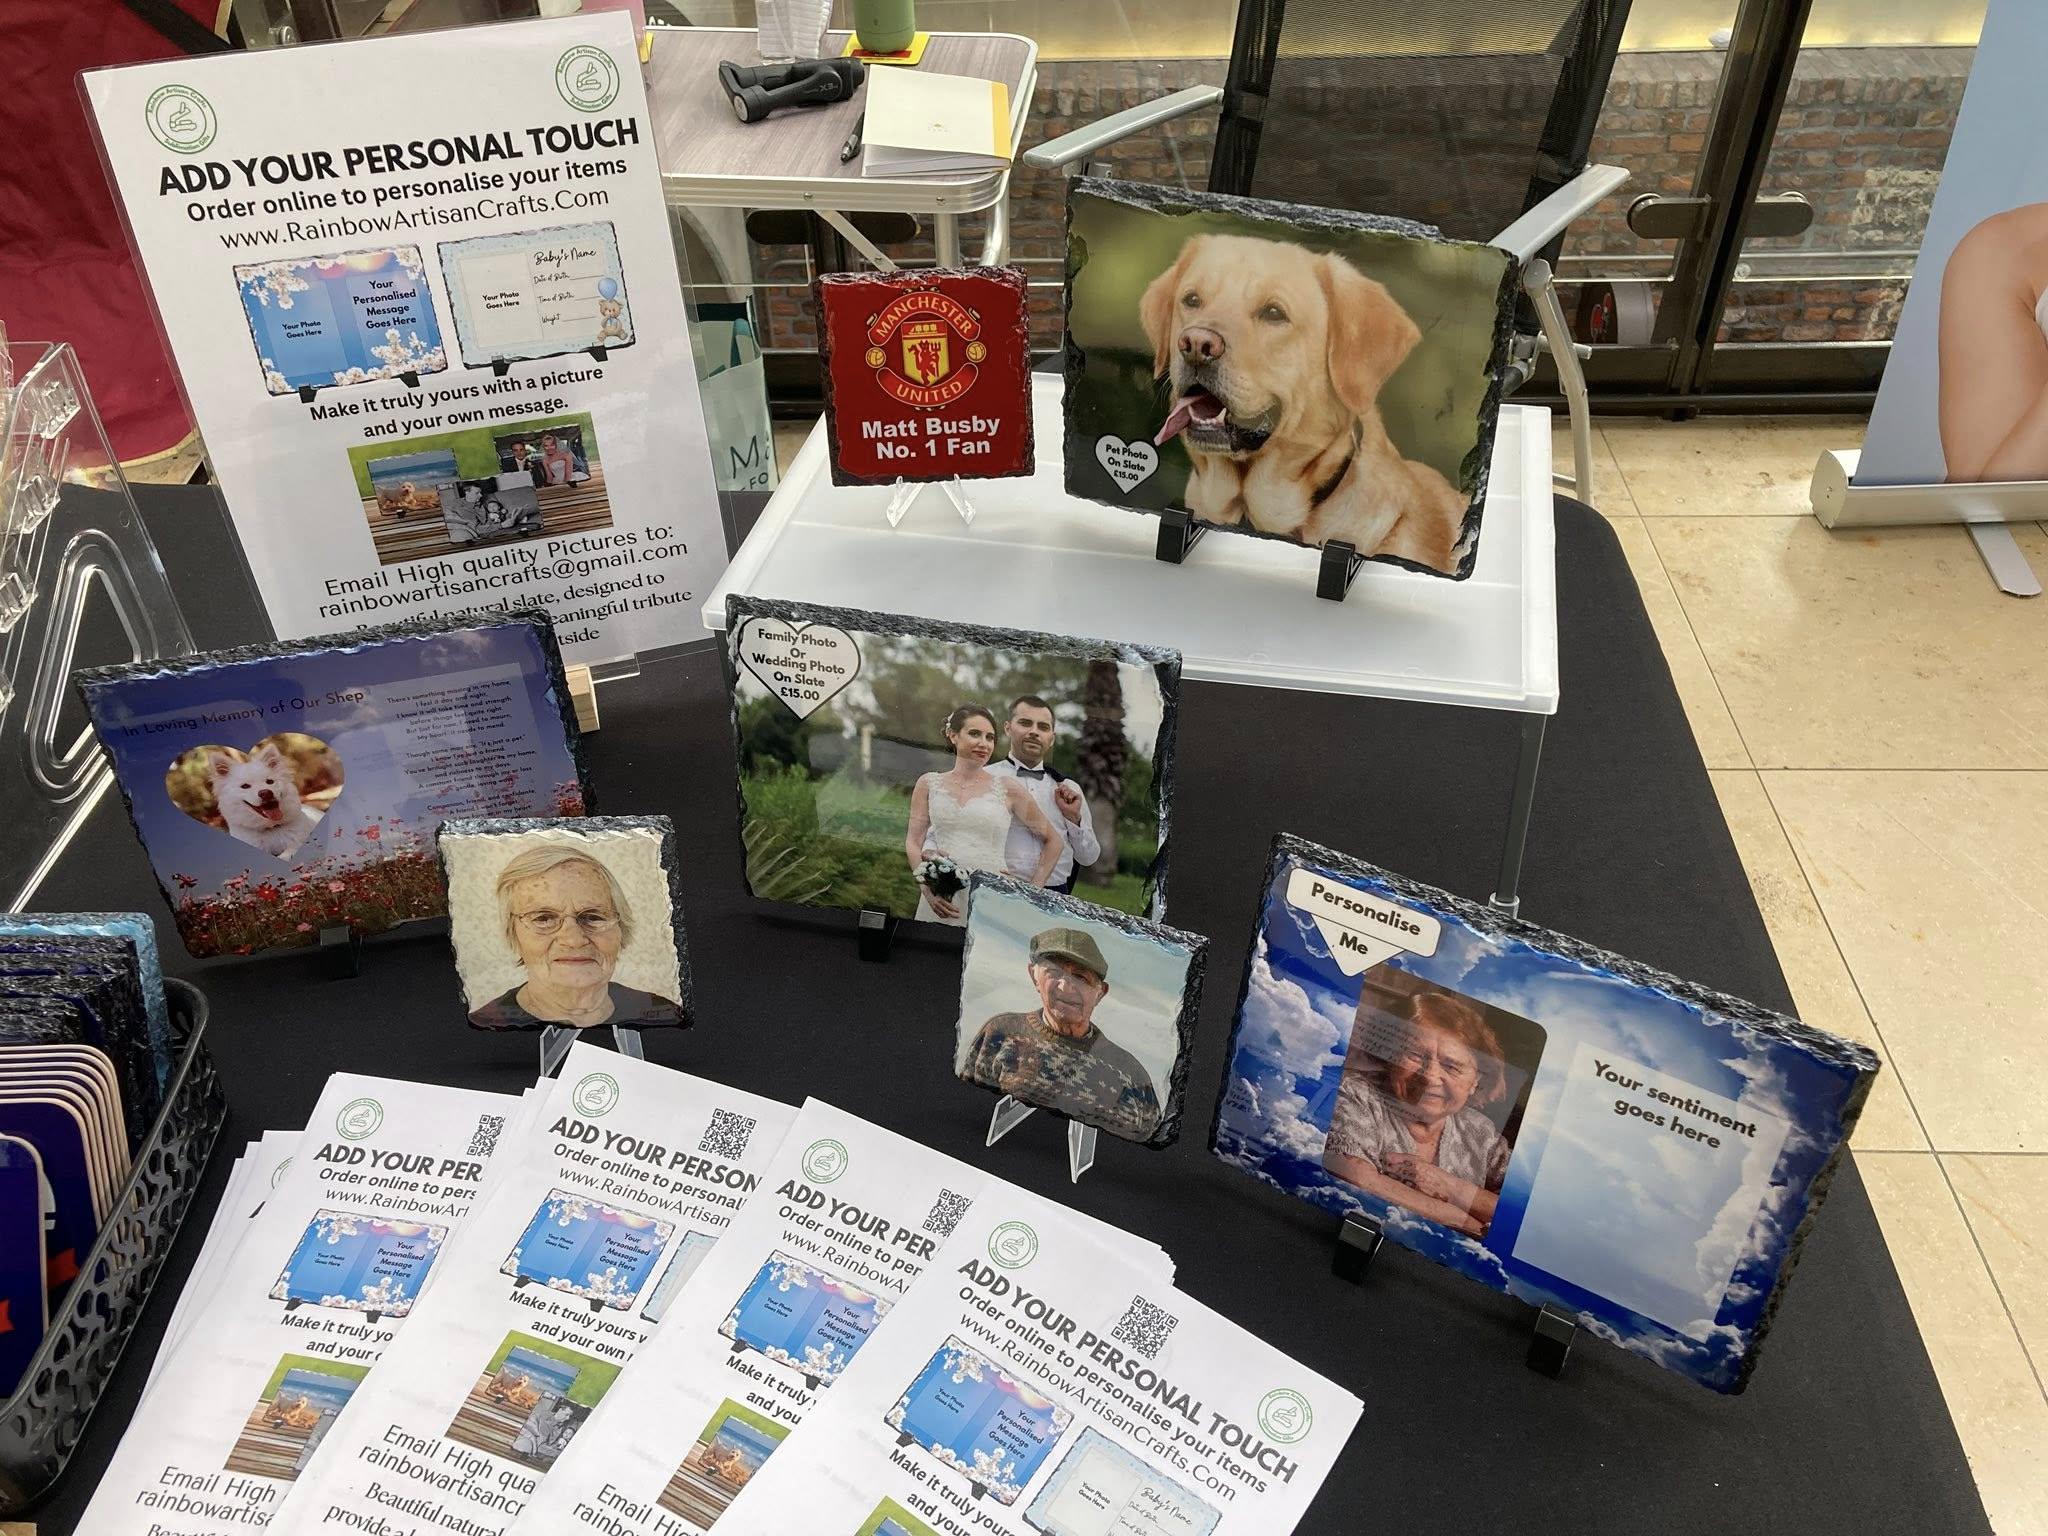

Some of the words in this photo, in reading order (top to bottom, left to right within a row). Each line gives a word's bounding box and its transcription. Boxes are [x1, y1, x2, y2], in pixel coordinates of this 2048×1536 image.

[160, 162, 231, 196] ADD
[232, 151, 340, 187] YOUR
[343, 131, 523, 176] PERSONAL
[526, 118, 639, 155] TOUCH
[187, 199, 256, 221] Order
[263, 191, 337, 214] online
[341, 189, 366, 205] to
[373, 173, 504, 207] personalise
[509, 167, 559, 191] your
[566, 160, 627, 179] items
[220, 190, 609, 248] www.RainbowArtisanCrafts.Com
[533, 249, 569, 267] Baby's
[571, 249, 597, 262] Name
[353, 288, 417, 305] Personalised
[369, 280, 394, 290] Your
[482, 293, 499, 302] Your
[500, 291, 520, 300] Photo
[366, 304, 410, 317] Message
[486, 301, 503, 310] Goes
[504, 299, 520, 308] Here
[876, 297, 973, 338] MANCHESTER
[366, 319, 391, 329] Goes
[392, 315, 417, 326] Here
[310, 402, 359, 420] Make
[363, 399, 378, 412] it
[380, 392, 423, 410] truly
[428, 386, 479, 407] yours
[483, 378, 522, 395] with
[526, 378, 537, 389] a
[541, 369, 603, 390] picture
[896, 381, 963, 403] UNITED
[364, 419, 398, 437] and
[401, 416, 442, 435] your
[448, 410, 484, 424] own
[488, 399, 568, 418] message.
[862, 419, 918, 439] Matt
[925, 415, 1001, 436] Busby
[876, 442, 916, 459] No.
[925, 440, 936, 456] 1
[947, 438, 991, 456] Fan
[1106, 444, 1120, 455] Pet
[1122, 447, 1148, 460] Photo
[1108, 457, 1120, 467] On
[1123, 460, 1145, 472] Slate
[1114, 470, 1138, 481] £15.00
[325, 571, 388, 596] Email
[398, 561, 453, 583] High
[463, 549, 537, 576] quality
[548, 533, 637, 558] Pictures
[645, 526, 673, 540] to:
[320, 544, 687, 618] rainbowartisancrafts@gmail.com
[513, 592, 560, 611] slate,
[564, 573, 643, 600] designed
[646, 574, 664, 585] to
[633, 592, 692, 610] tribute
[758, 628, 798, 645] Family
[801, 634, 837, 648] Photo
[790, 648, 806, 659] Or
[752, 652, 807, 672] Wedding
[810, 660, 845, 674] Photo
[773, 671, 792, 683] On
[794, 674, 825, 687] Slate
[780, 687, 820, 700] £15.00
[123, 726, 139, 737] In
[144, 718, 198, 734] Loving
[203, 707, 265, 725] Memory
[270, 700, 285, 715] of
[291, 698, 321, 710] Our
[326, 690, 364, 706] Shep
[1311, 882, 1421, 936] Personalise
[1339, 932, 1369, 955] Me
[1594, 1059, 1643, 1091] Your
[1647, 1087, 1757, 1138] sentiment
[1613, 1098, 1665, 1127] goes
[1670, 1116, 1721, 1149] here
[548, 1117, 599, 1143] ADD
[604, 1130, 666, 1166] YOUR
[313, 1144, 366, 1164] ADD
[371, 1149, 434, 1175] YOUR
[554, 1144, 600, 1166] Order
[601, 1160, 649, 1181] online
[653, 1174, 669, 1187] to
[320, 1168, 367, 1184] Order
[369, 1176, 419, 1191] online
[423, 1182, 439, 1194] to
[775, 1180, 826, 1209] ADD
[829, 1198, 890, 1241] YOUR
[779, 1206, 824, 1231] Order
[824, 1228, 872, 1254] online
[875, 1248, 891, 1263] to
[281, 1314, 320, 1329] Make
[322, 1320, 336, 1332] it
[337, 1323, 373, 1341] truly
[509, 1291, 546, 1310] Make
[547, 1302, 560, 1315] it
[561, 1308, 596, 1328] truly
[594, 1321, 637, 1340] yours
[726, 1356, 762, 1380] Make
[763, 1374, 776, 1387] it
[777, 1380, 810, 1406] truly
[957, 1259, 1010, 1296] ADD
[1011, 1286, 1076, 1343] YOUR
[1076, 1331, 1202, 1426] PERSONAL
[1208, 1412, 1298, 1484] TOUCH
[746, 1392, 776, 1411] and
[959, 1287, 1005, 1320] Order
[1005, 1319, 1055, 1355] online
[1057, 1350, 1074, 1367] to
[1073, 1365, 1172, 1431] personalise
[1170, 1427, 1216, 1457] your
[1216, 1452, 1267, 1493] items
[960, 1314, 1236, 1501] www.RainbowArtisanCrafts.Com
[1018, 1409, 1036, 1426] Your
[997, 1409, 1045, 1445] Personalised
[997, 1423, 1029, 1449] Message
[383, 1424, 441, 1458] Email
[443, 1447, 493, 1479] High
[988, 1430, 1007, 1447] Goes
[1007, 1444, 1025, 1459] Here
[159, 1466, 220, 1493] Email
[224, 1478, 276, 1505] High
[889, 1449, 926, 1481] Make
[926, 1475, 940, 1491] it
[940, 1485, 975, 1516] truly
[365, 1482, 444, 1522] Beautiful
[597, 1483, 652, 1524] Email
[907, 1494, 938, 1517] and
